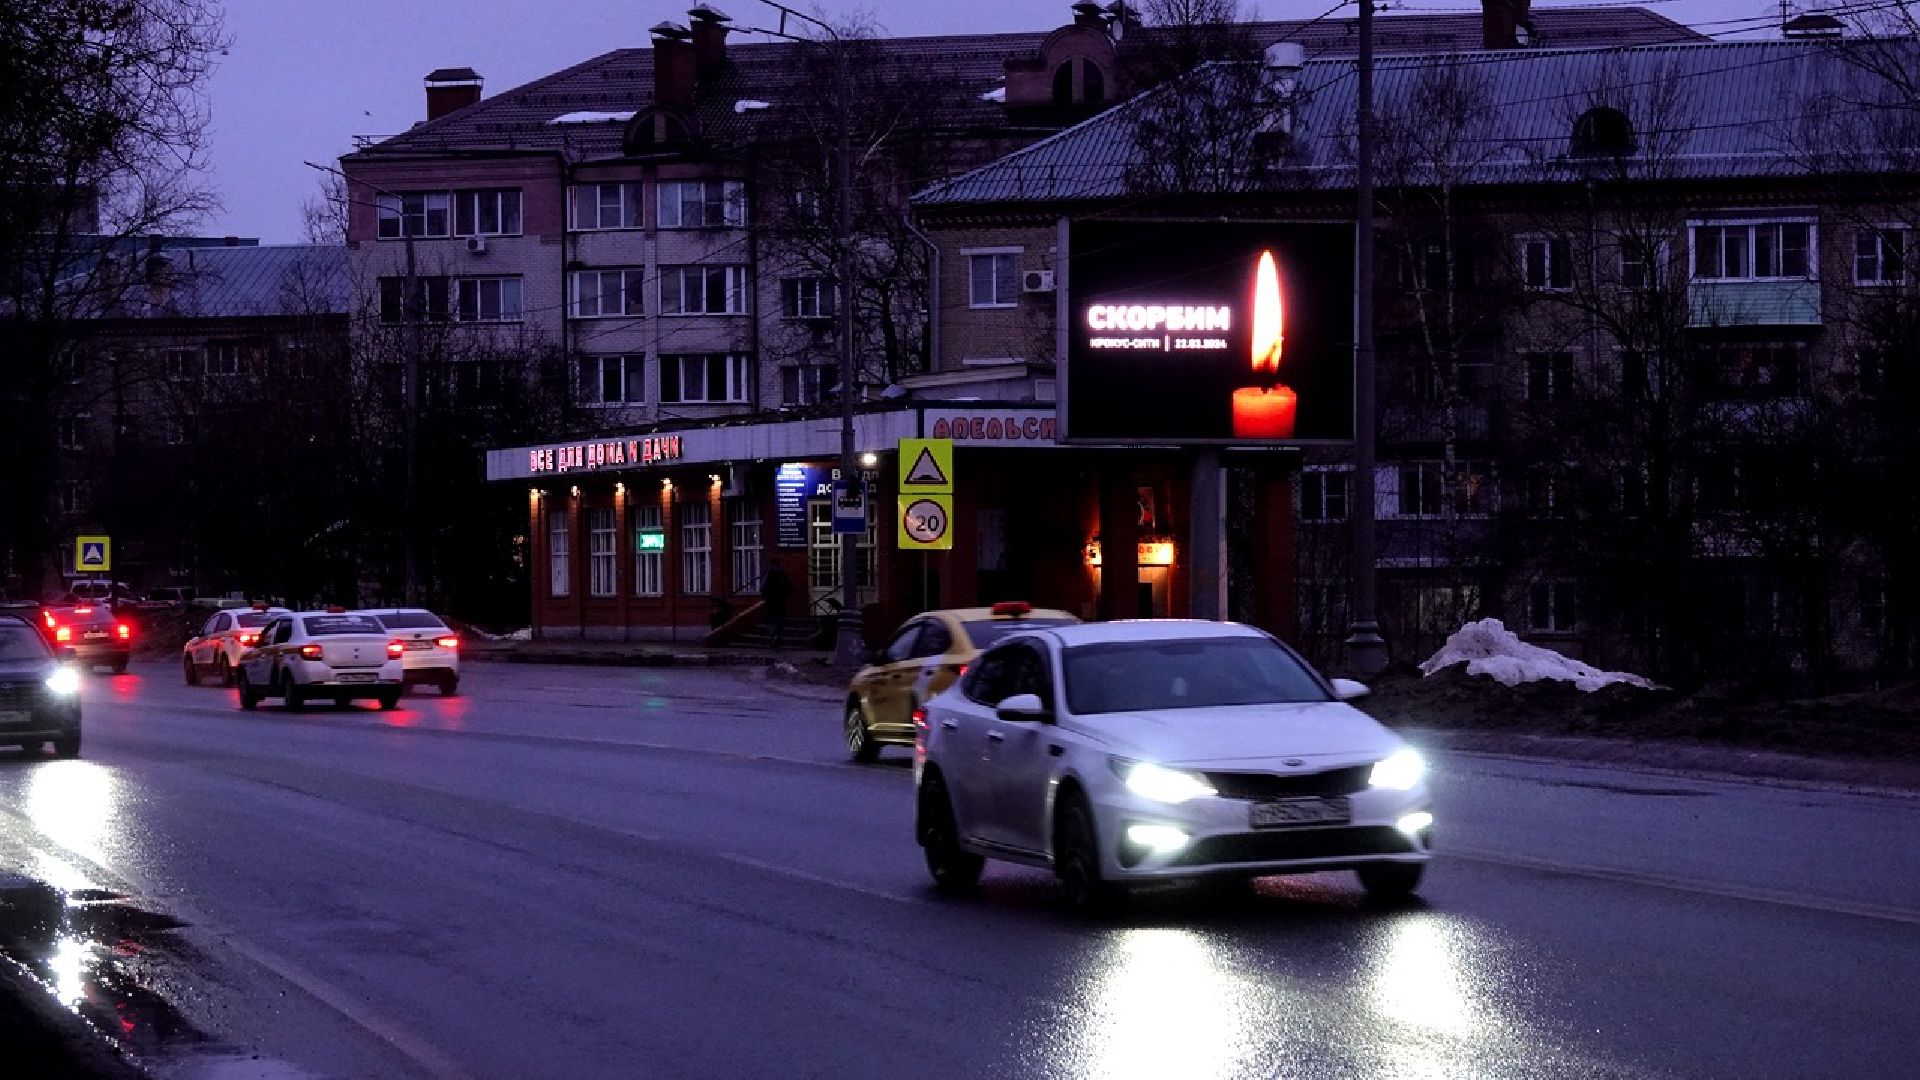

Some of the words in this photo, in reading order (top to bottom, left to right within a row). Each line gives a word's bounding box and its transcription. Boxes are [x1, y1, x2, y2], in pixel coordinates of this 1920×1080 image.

[1088, 305, 1230, 331] СКОРБИМ
[530, 449, 553, 472] ВСЕ
[558, 446, 583, 472] ДЛЯ
[588, 442, 625, 469] ДОМА
[629, 440, 638, 463] И
[642, 435, 679, 464] ДАЧИ
[915, 515, 939, 532] 20
